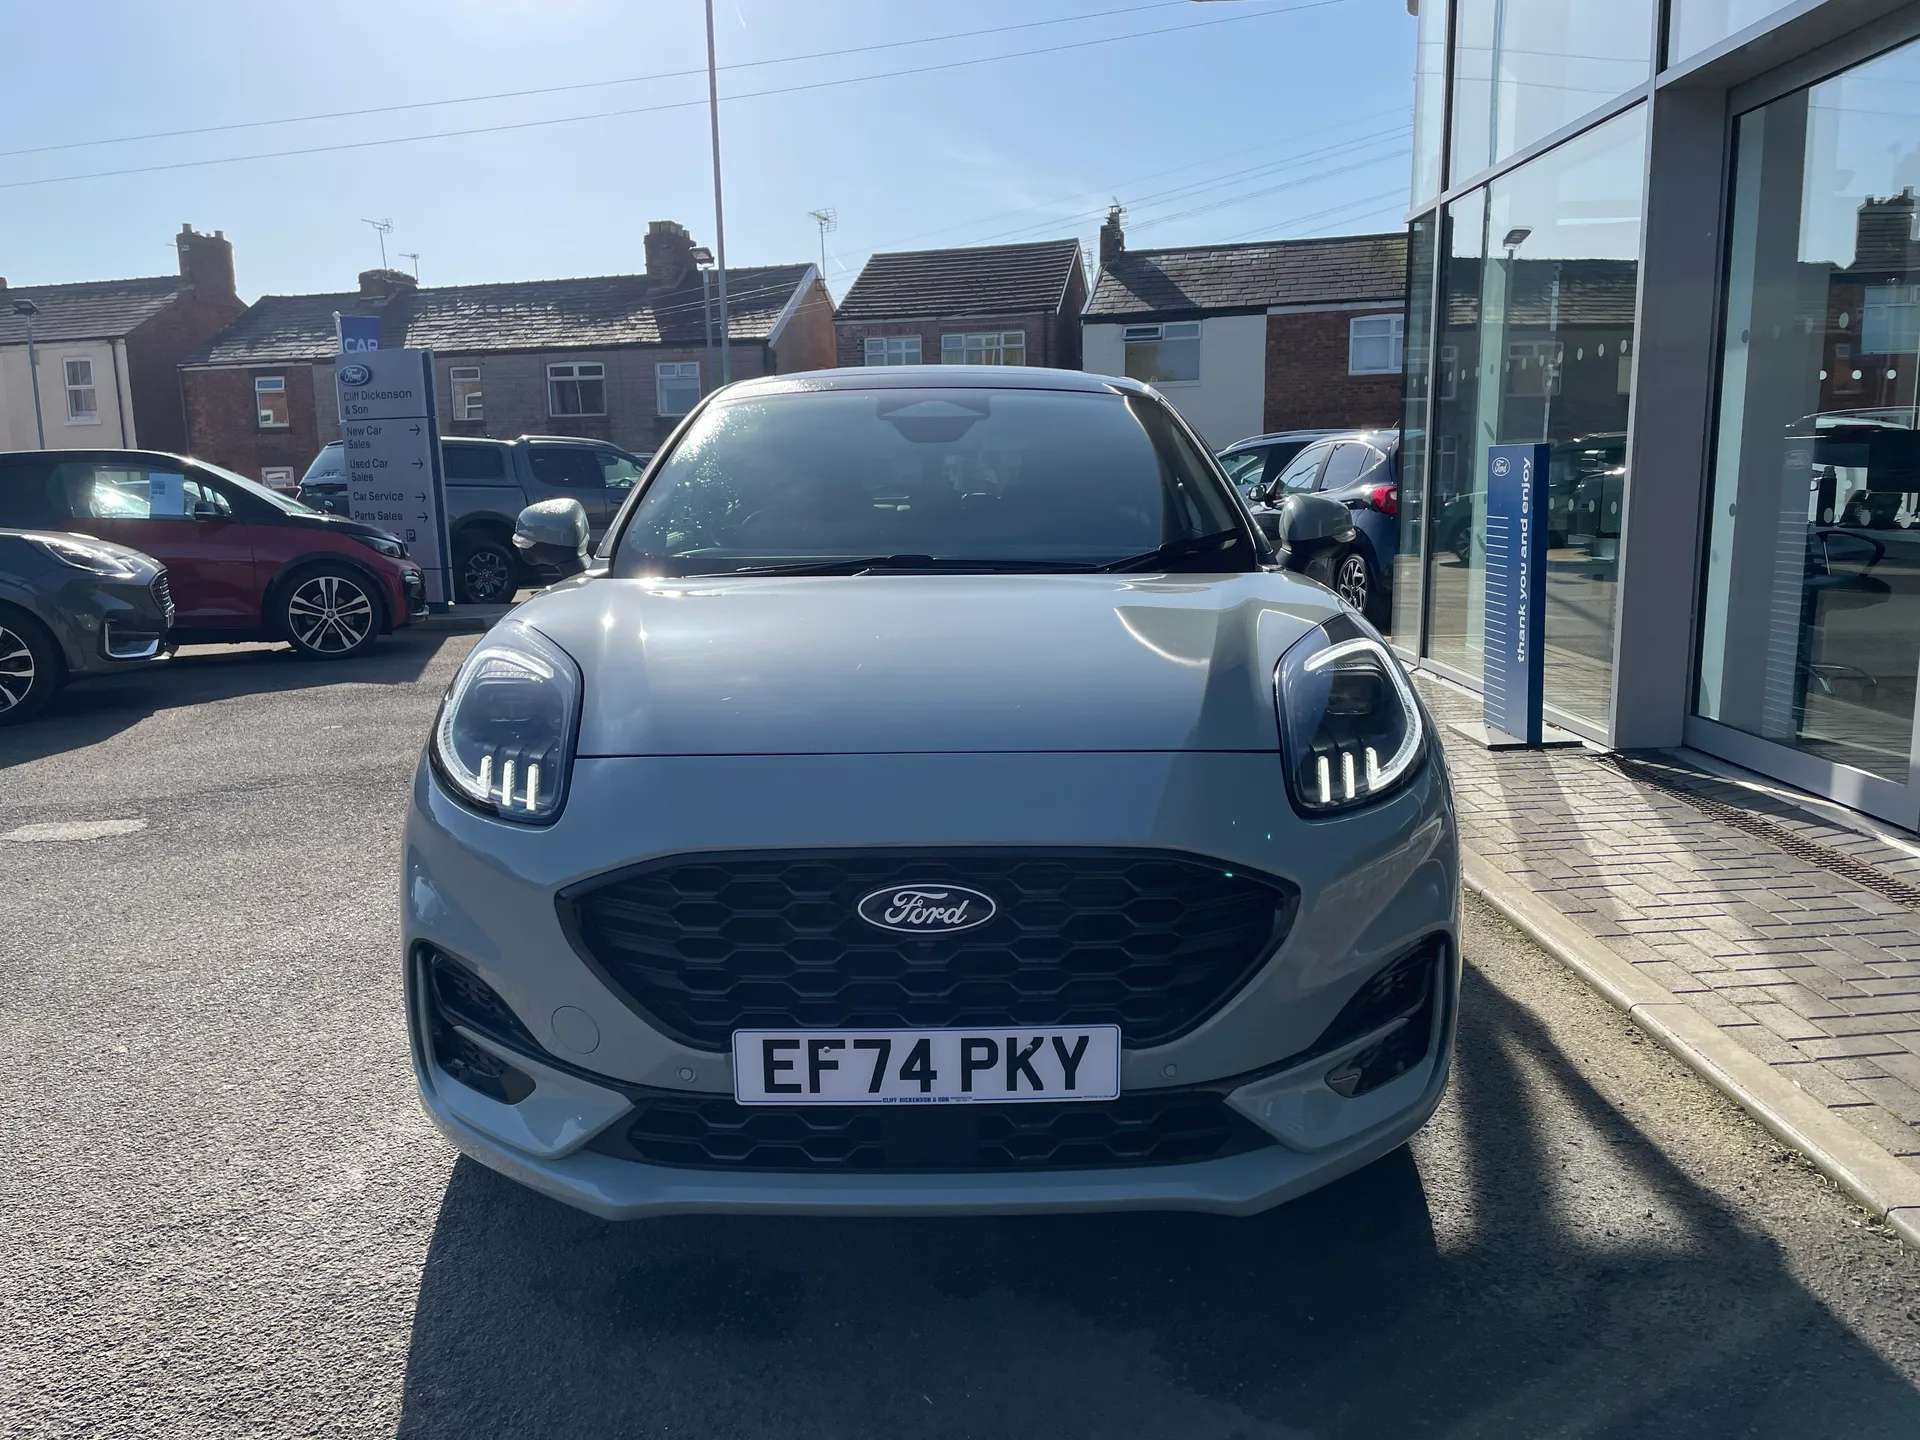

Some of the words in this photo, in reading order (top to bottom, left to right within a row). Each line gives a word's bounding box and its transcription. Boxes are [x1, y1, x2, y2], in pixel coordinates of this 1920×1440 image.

[344, 338, 378, 353] CAR
[343, 391, 360, 401] Cliff
[361, 390, 412, 400] Dickenson
[345, 405, 351, 415] &
[352, 405, 369, 415] Son
[346, 426, 365, 436] New
[366, 425, 383, 436] Car
[348, 440, 371, 449] Sales
[350, 459, 370, 469] Used
[372, 458, 388, 469] Car
[351, 472, 374, 482] Sales
[1521, 456, 1531, 514] enjoy
[353, 491, 367, 501] Car
[368, 491, 404, 501] Service
[354, 510, 375, 520] Parts
[377, 511, 404, 521] Sales
[1520, 518, 1528, 559] and
[1520, 562, 1528, 600] you
[1517, 603, 1526, 663] thank
[885, 890, 970, 924] Ford
[763, 1038, 938, 1094] EF74
[960, 1035, 1090, 1092] PKY
